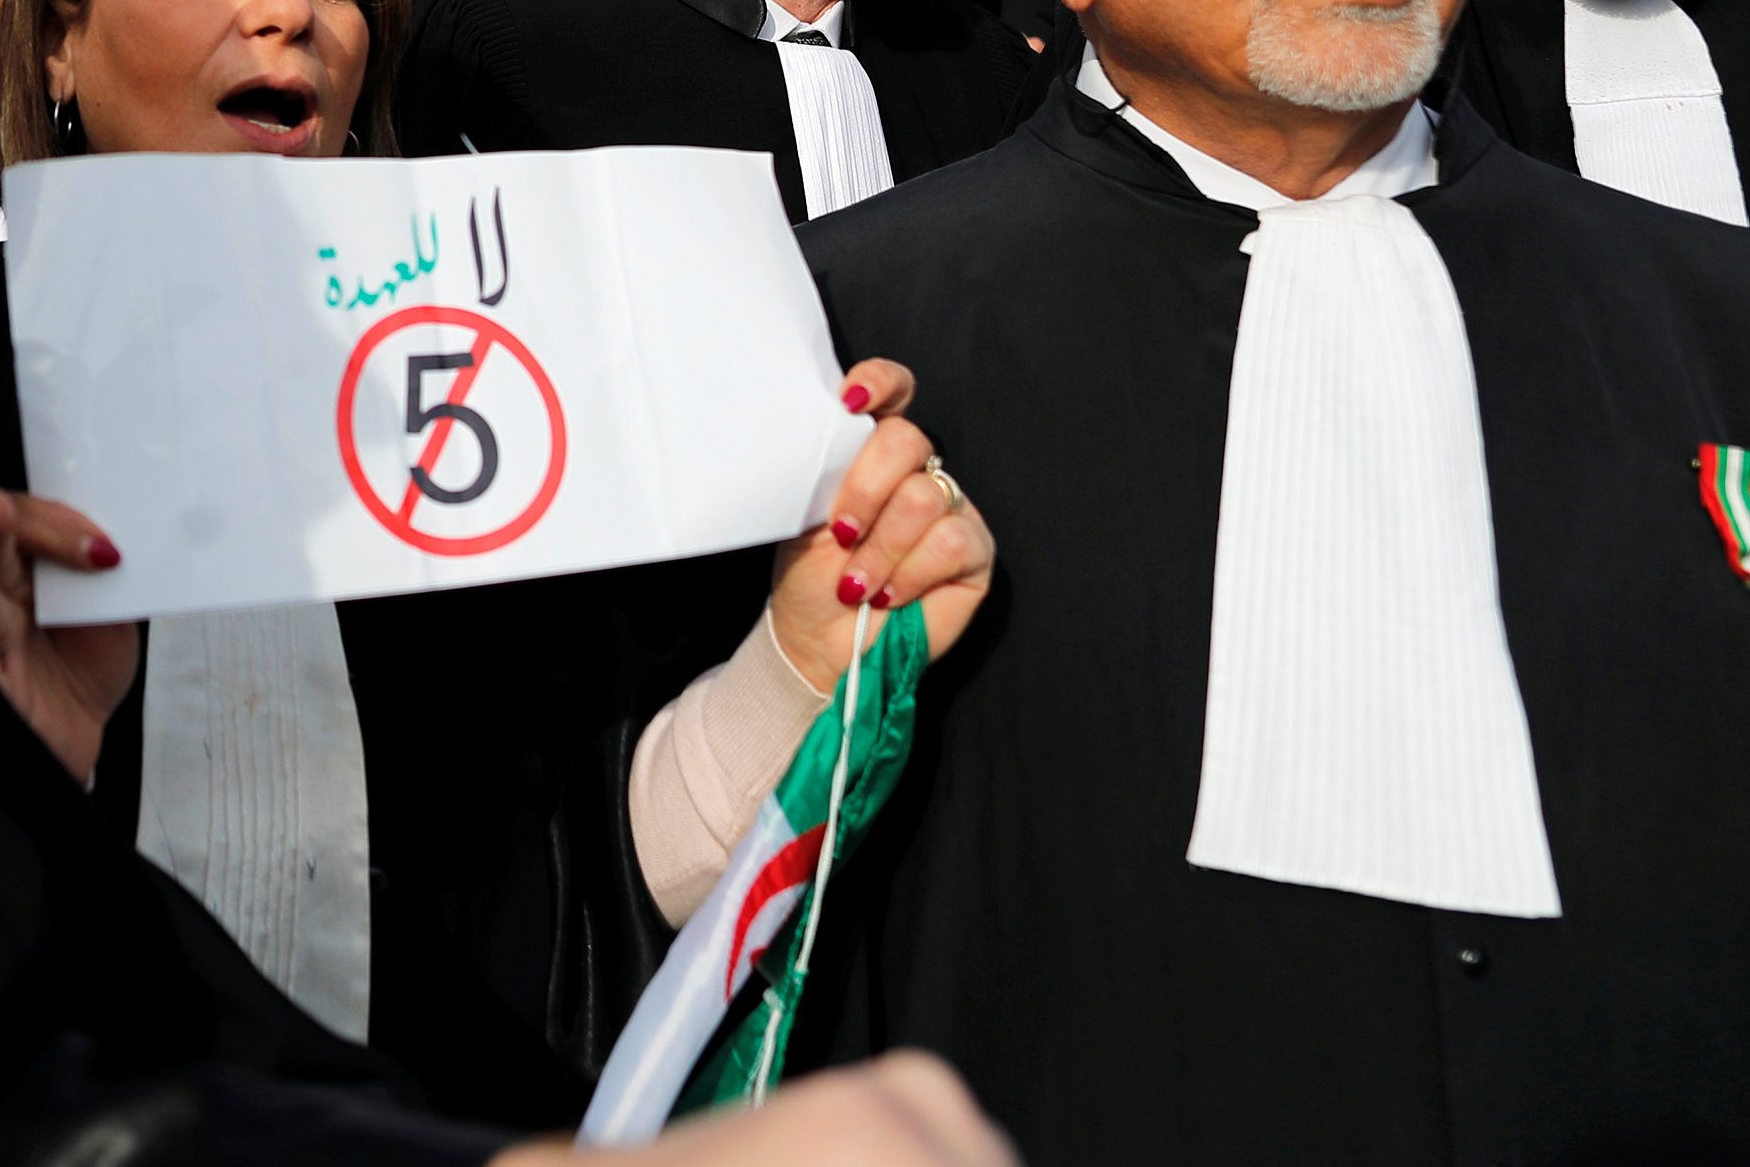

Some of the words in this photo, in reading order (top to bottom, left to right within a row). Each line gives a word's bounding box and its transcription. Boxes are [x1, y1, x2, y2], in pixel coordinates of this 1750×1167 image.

[317, 212, 440, 311] للعهدة
[470, 186, 509, 307] لا
[406, 352, 499, 504] 5
